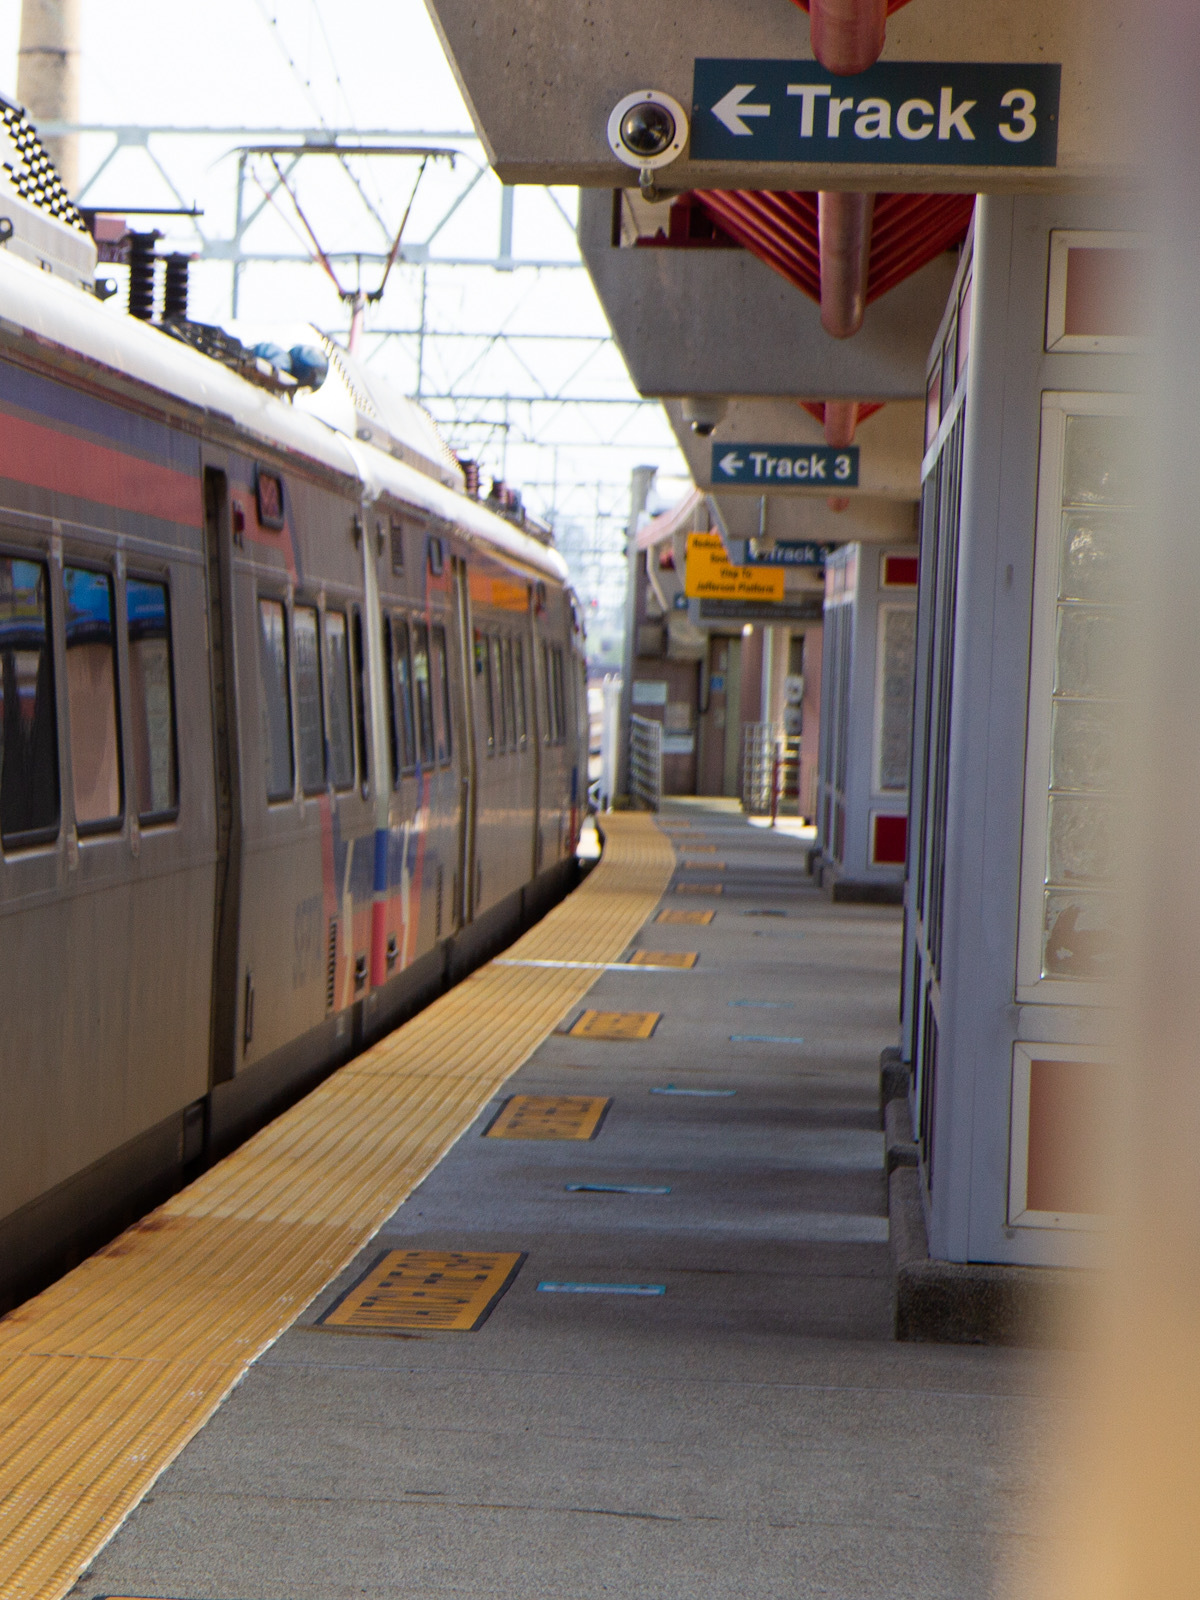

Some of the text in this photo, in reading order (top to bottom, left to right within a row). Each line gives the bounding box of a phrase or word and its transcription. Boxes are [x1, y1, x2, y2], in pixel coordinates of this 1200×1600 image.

[786, 84, 1037, 143] Track 3
[749, 452, 852, 480] Track 3
